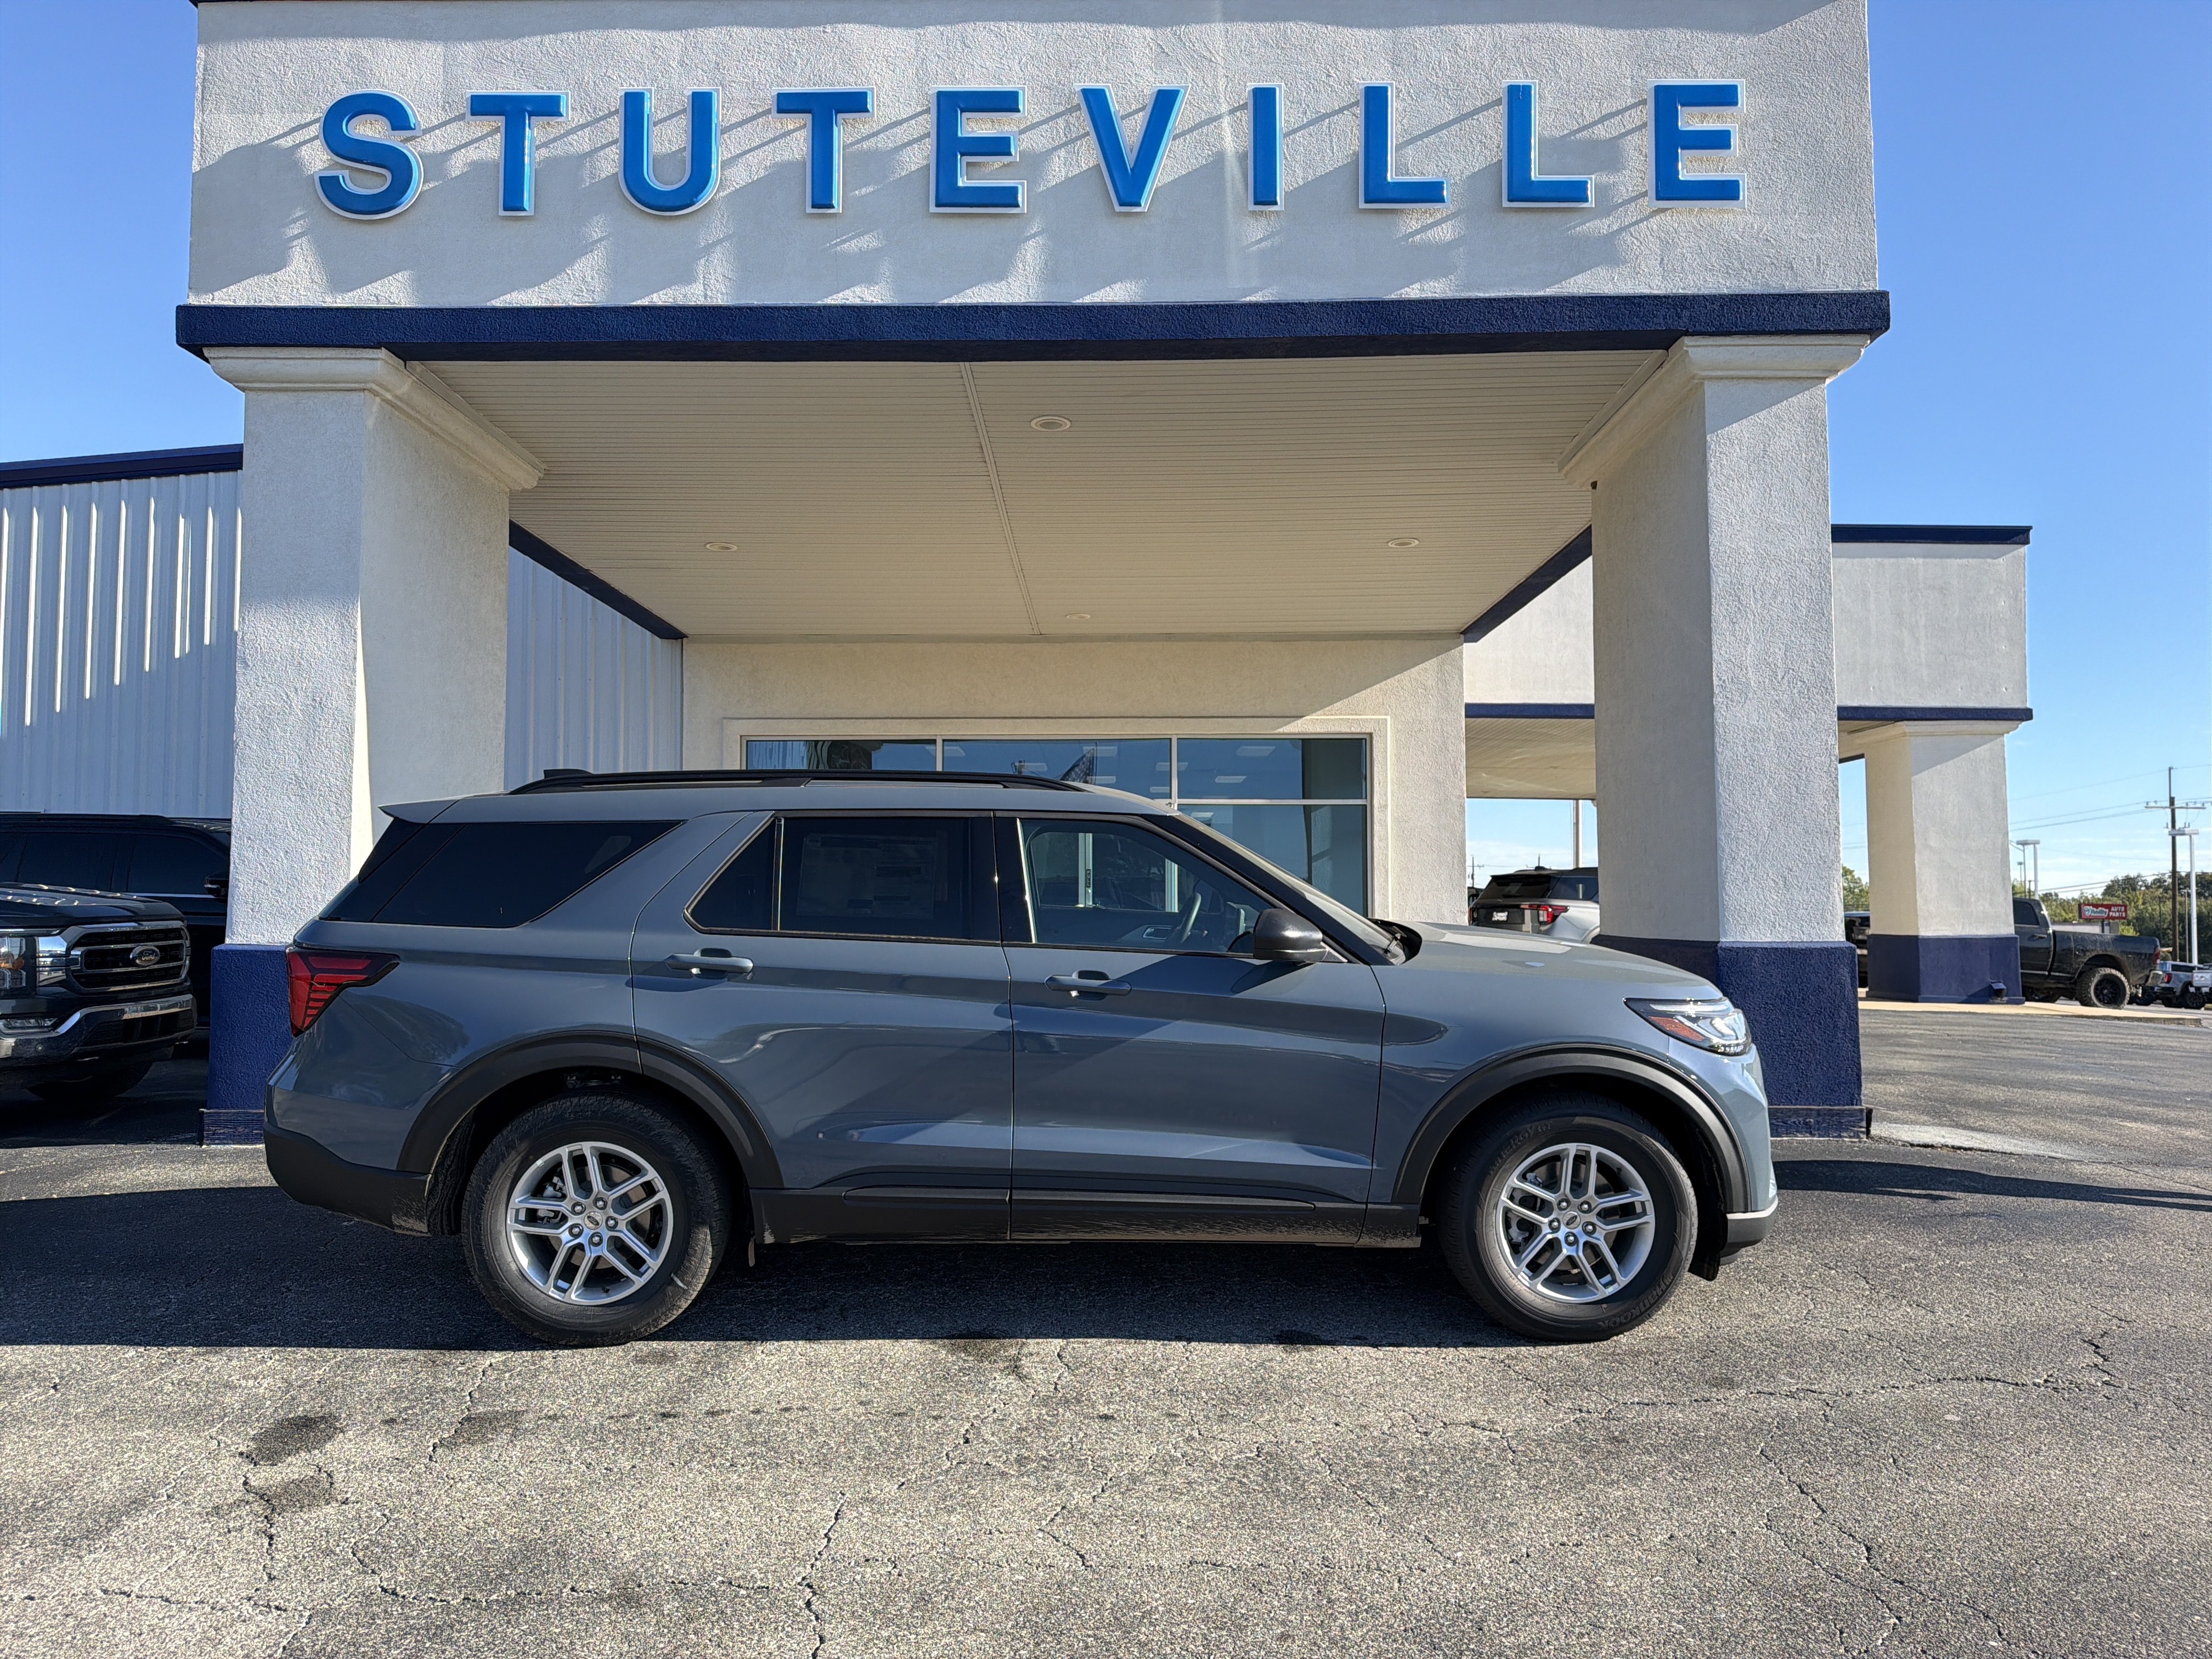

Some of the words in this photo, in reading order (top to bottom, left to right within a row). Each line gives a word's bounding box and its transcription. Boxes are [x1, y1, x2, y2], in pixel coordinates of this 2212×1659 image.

[314, 79, 1747, 219] STUTEVILLE
[2084, 907, 2107, 916] O'Reilly
[142, 950, 156, 961] Ford
